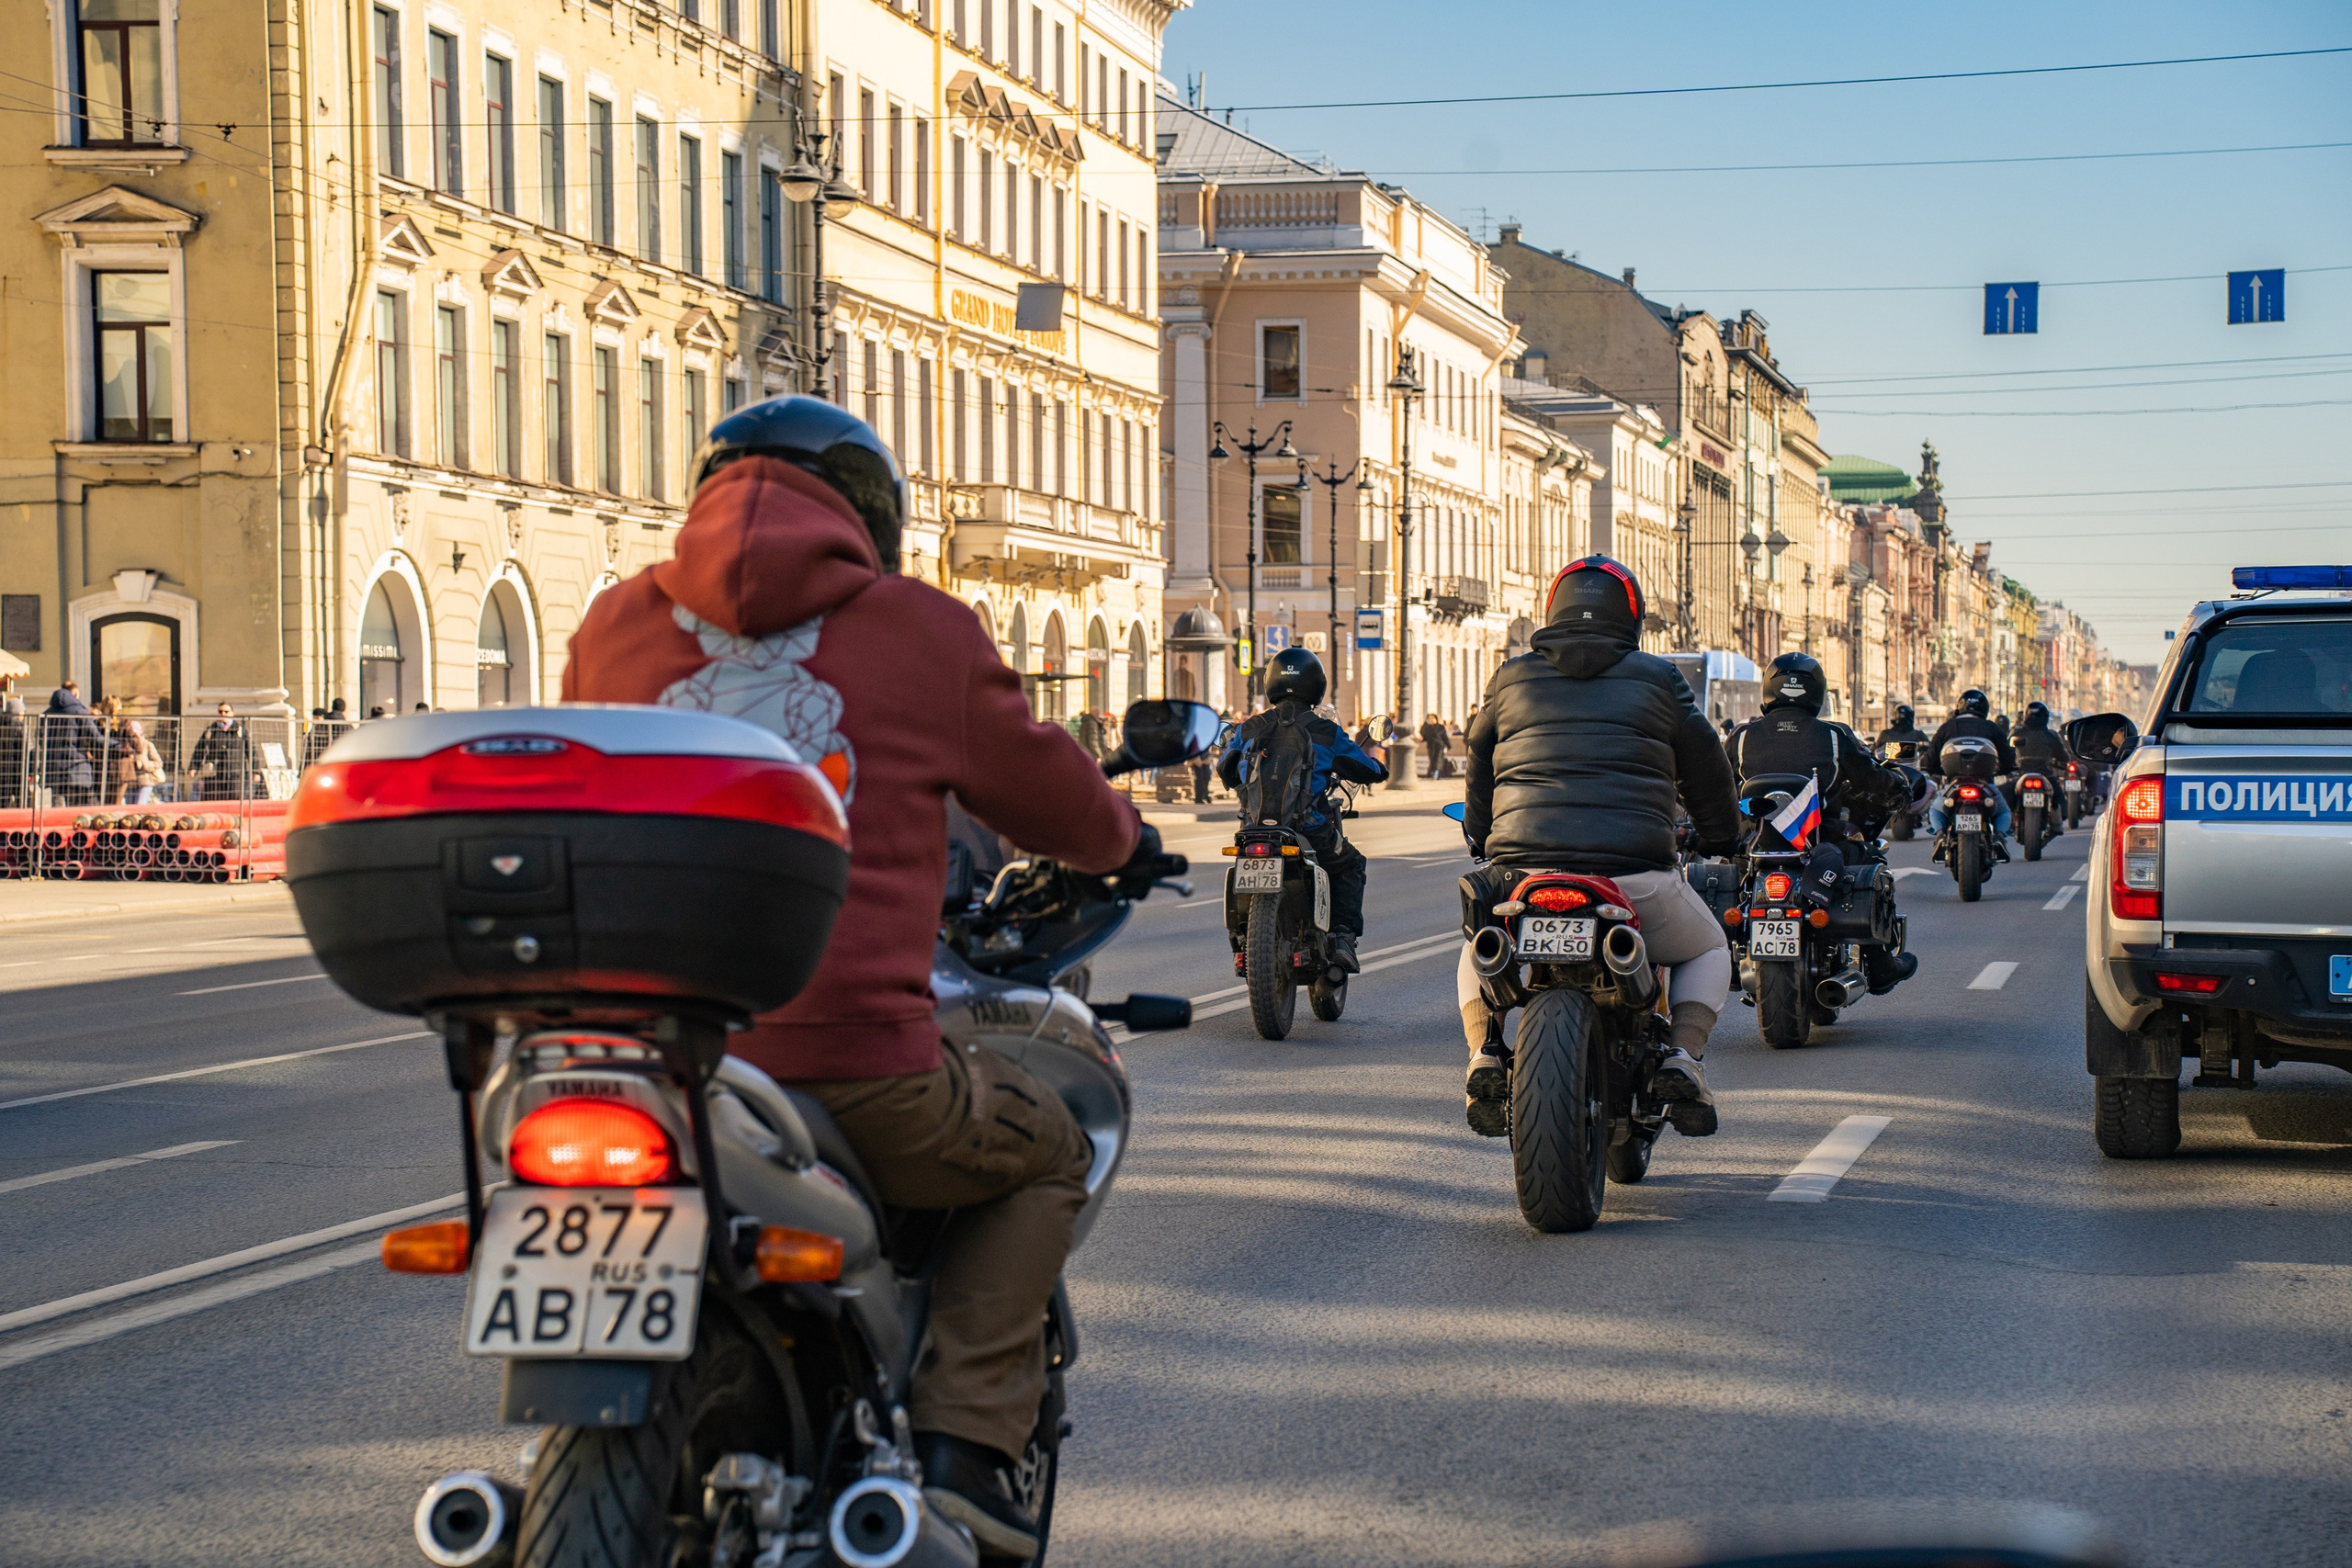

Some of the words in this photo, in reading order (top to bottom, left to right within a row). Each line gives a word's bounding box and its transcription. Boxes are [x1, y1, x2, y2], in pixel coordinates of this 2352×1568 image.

[952, 288, 989, 329] GRAND
[2181, 781, 2352, 818] ПОЛИЦИ
[1242, 859, 1275, 871] 6873
[1262, 875, 1278, 887] 78
[1532, 919, 1584, 933] 0673
[1758, 922, 1793, 935] 7965
[1522, 939, 1555, 953] BK
[1563, 940, 1589, 953] 50
[1779, 942, 1796, 954] 78
[514, 1205, 674, 1258] 2877
[591, 1262, 648, 1282] RUS
[480, 1288, 573, 1343] AB
[604, 1288, 676, 1343] 78
